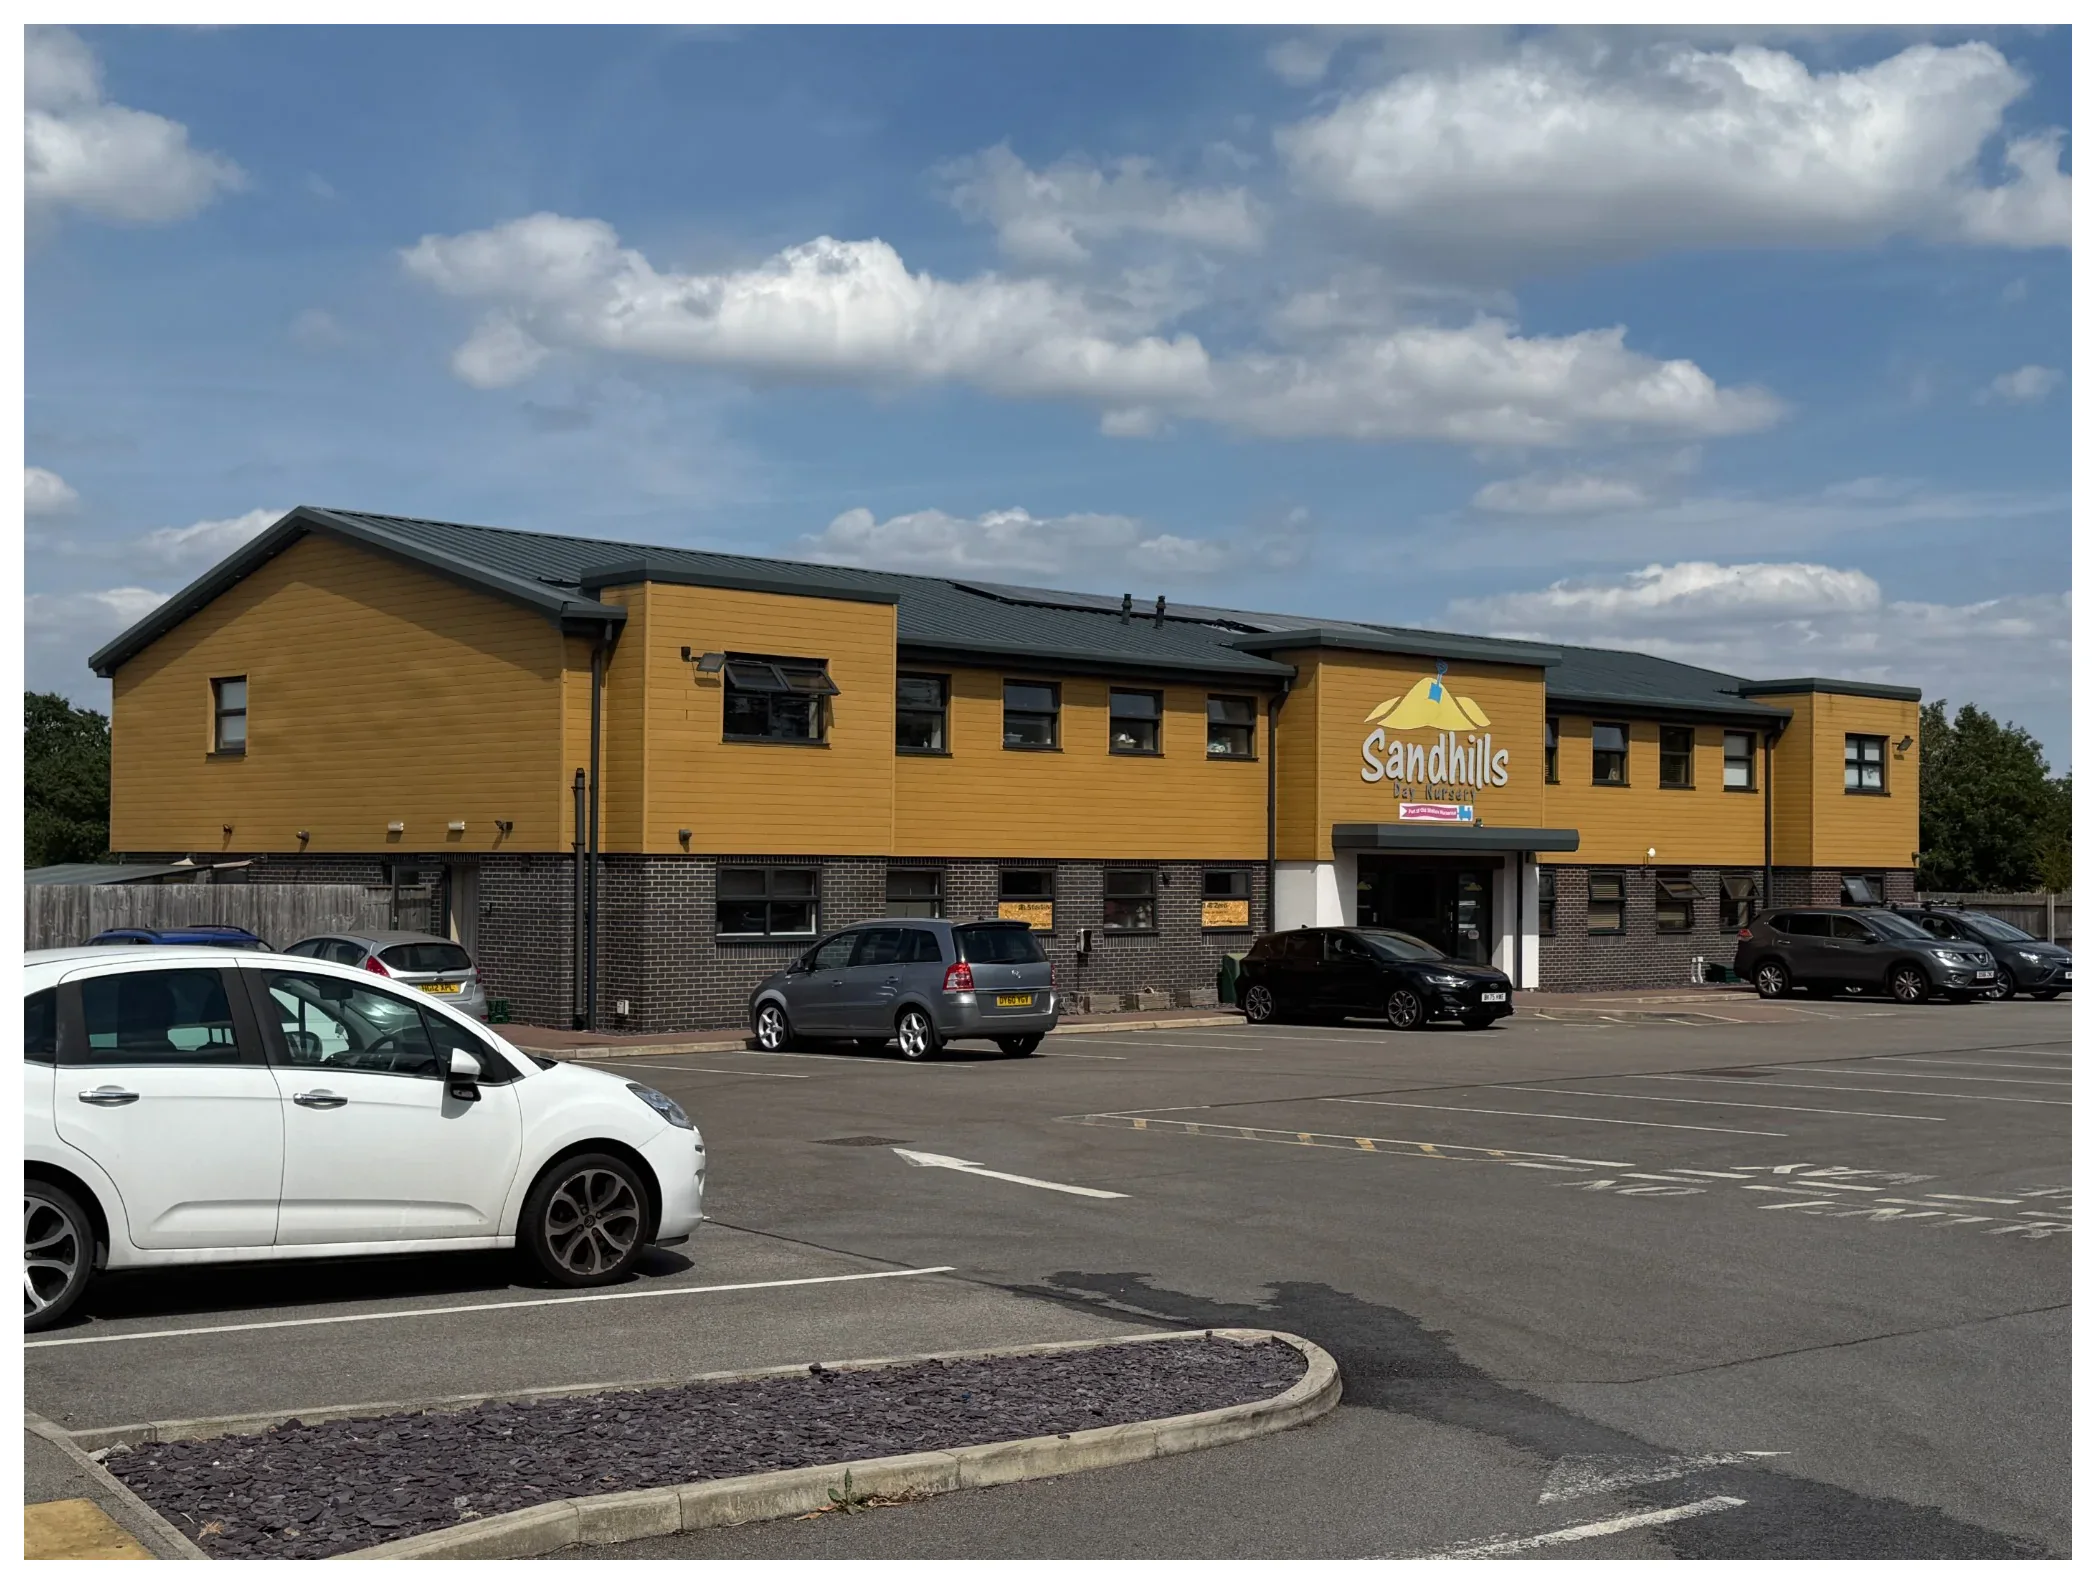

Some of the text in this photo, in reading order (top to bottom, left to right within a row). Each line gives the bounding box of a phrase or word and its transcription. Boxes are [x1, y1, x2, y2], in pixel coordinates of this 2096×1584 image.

[1361, 727, 1509, 789] Sandhills
[1394, 781, 1477, 803] Day Nursery
[1000, 996, 1015, 1004] DY60
[1730, 1163, 1940, 1185] WAY
[1549, 1180, 1707, 1196] NO
